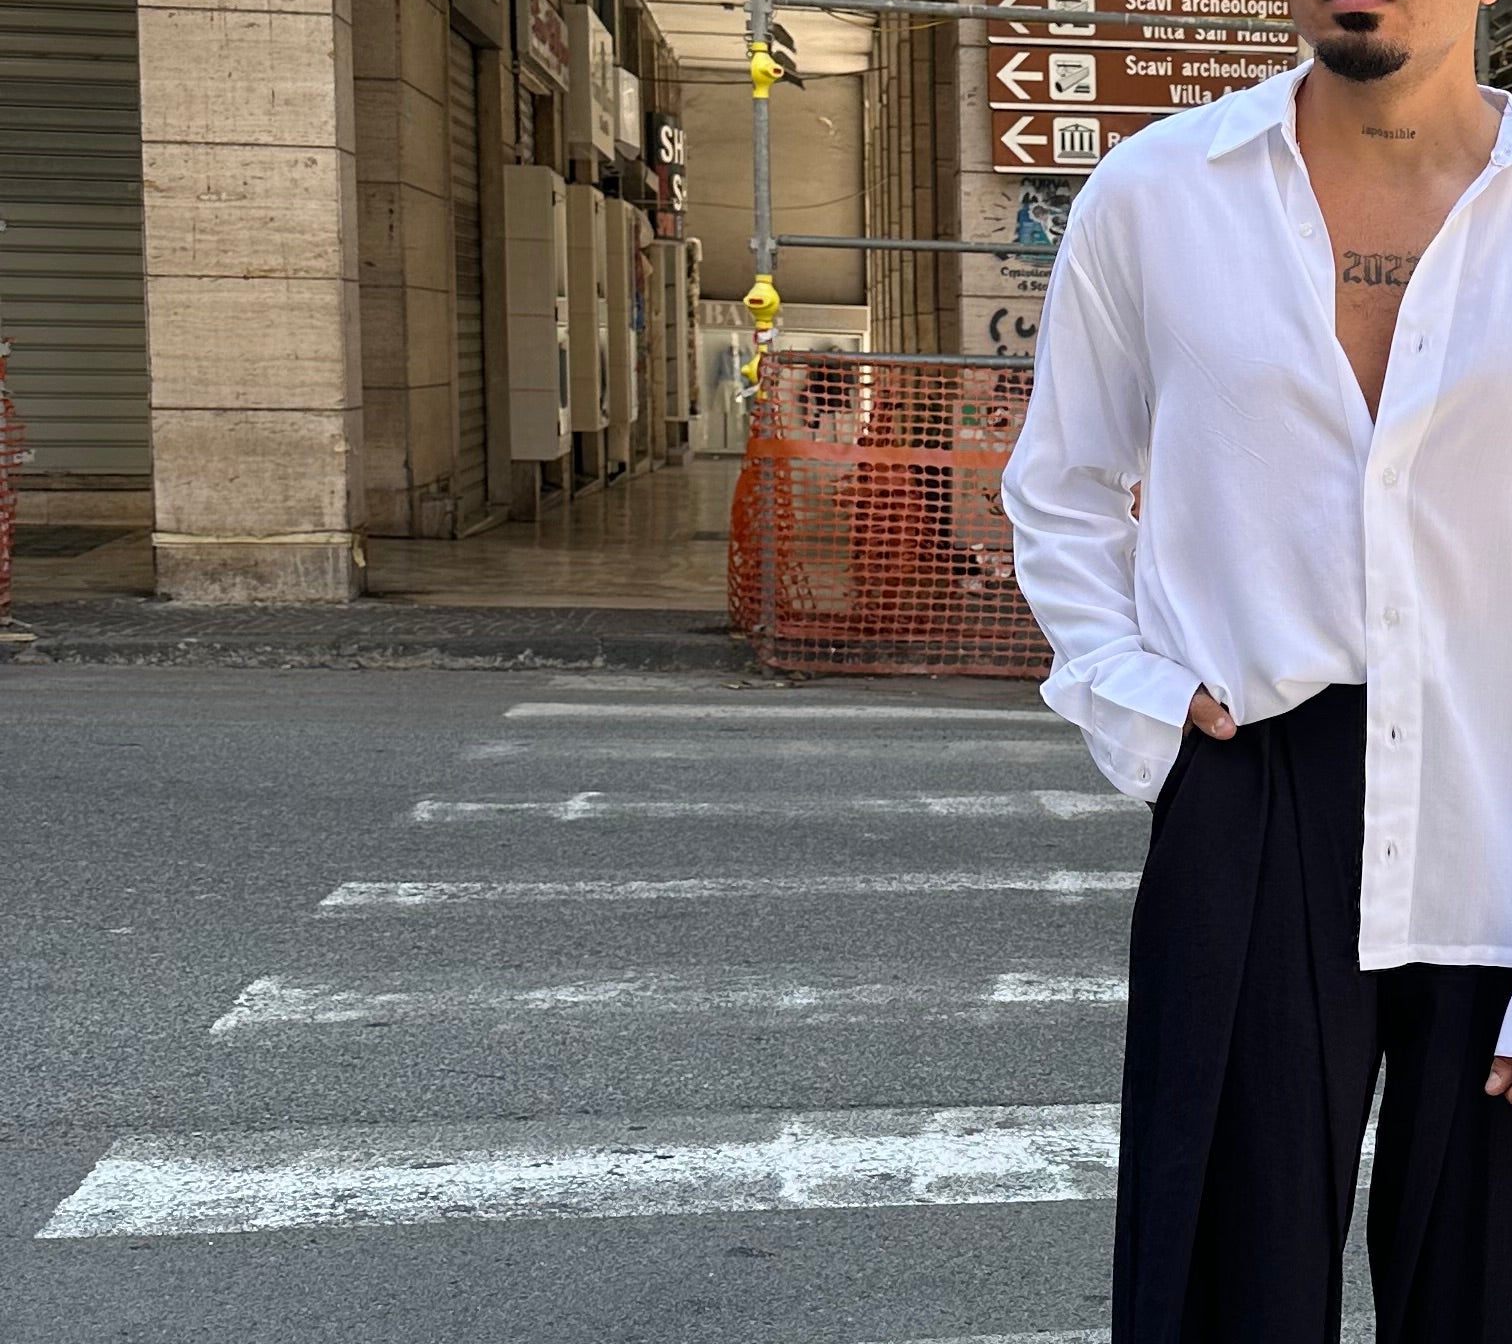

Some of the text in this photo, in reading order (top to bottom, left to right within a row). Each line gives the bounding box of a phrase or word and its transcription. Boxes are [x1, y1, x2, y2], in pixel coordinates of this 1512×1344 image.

[1125, 54, 1172, 76] Scavi
[1169, 83, 1212, 104] Villa
[1361, 124, 1416, 140] impossible
[660, 124, 686, 165] SH
